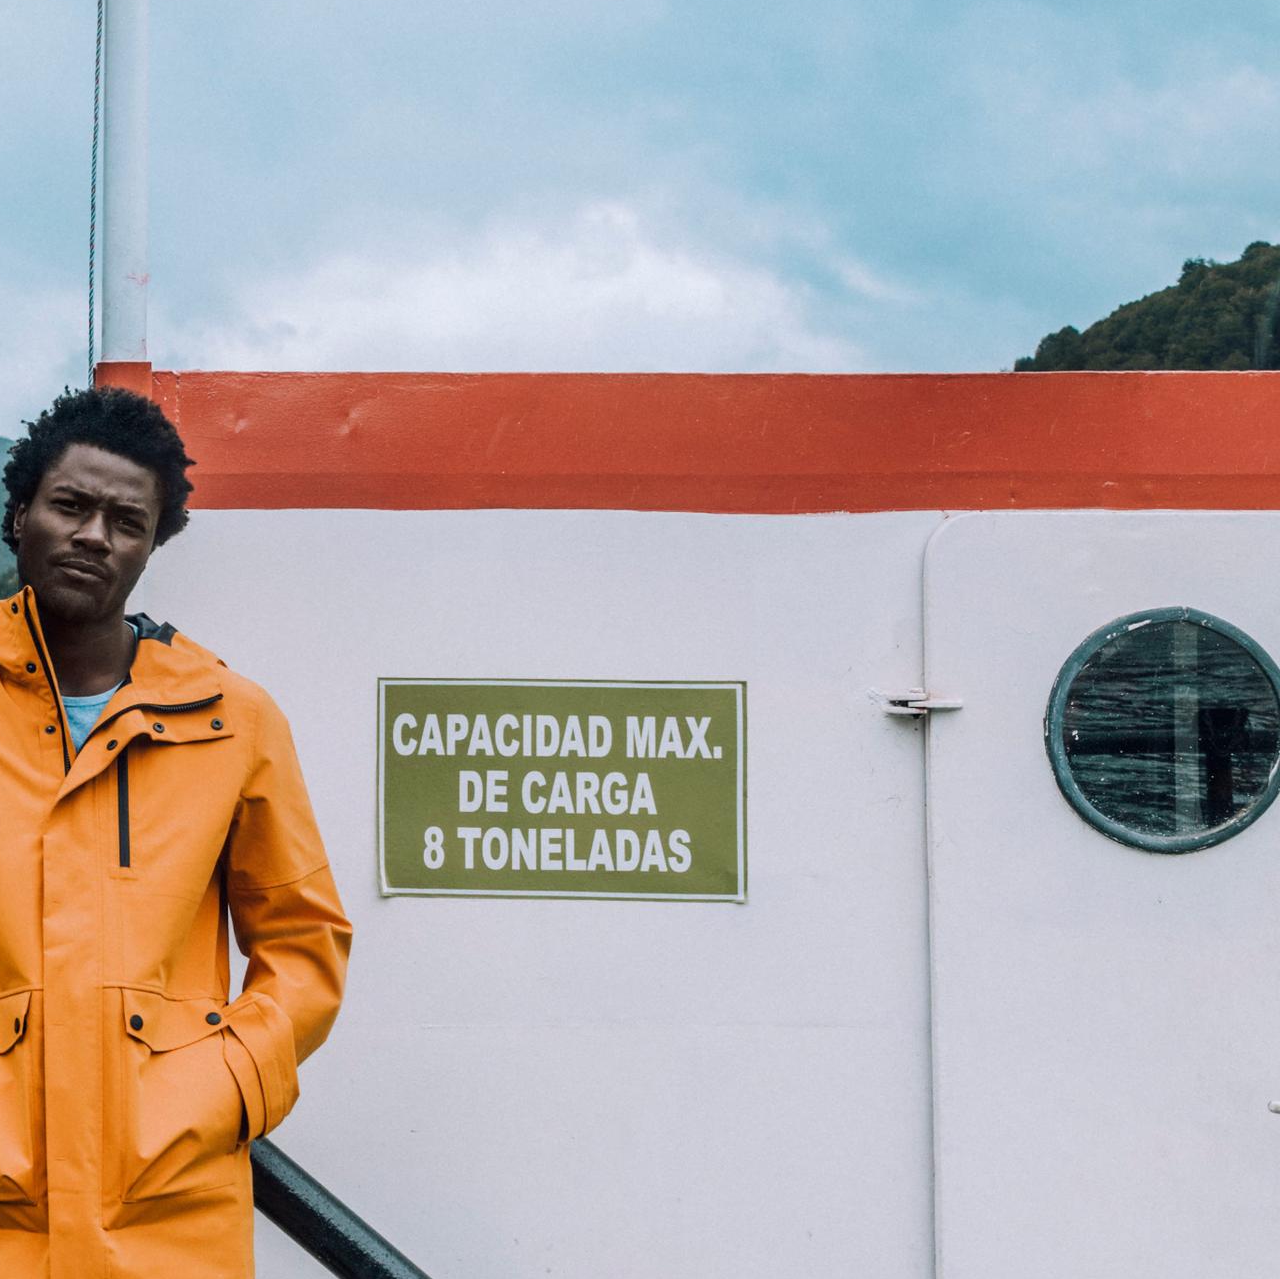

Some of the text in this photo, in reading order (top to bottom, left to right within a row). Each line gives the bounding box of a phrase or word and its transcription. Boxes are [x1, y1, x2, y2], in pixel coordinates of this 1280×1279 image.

[392, 712, 723, 759] CAPACIDAD MAX.
[458, 770, 658, 815] DE CARGA
[422, 825, 693, 873] 8 TONELADAS
